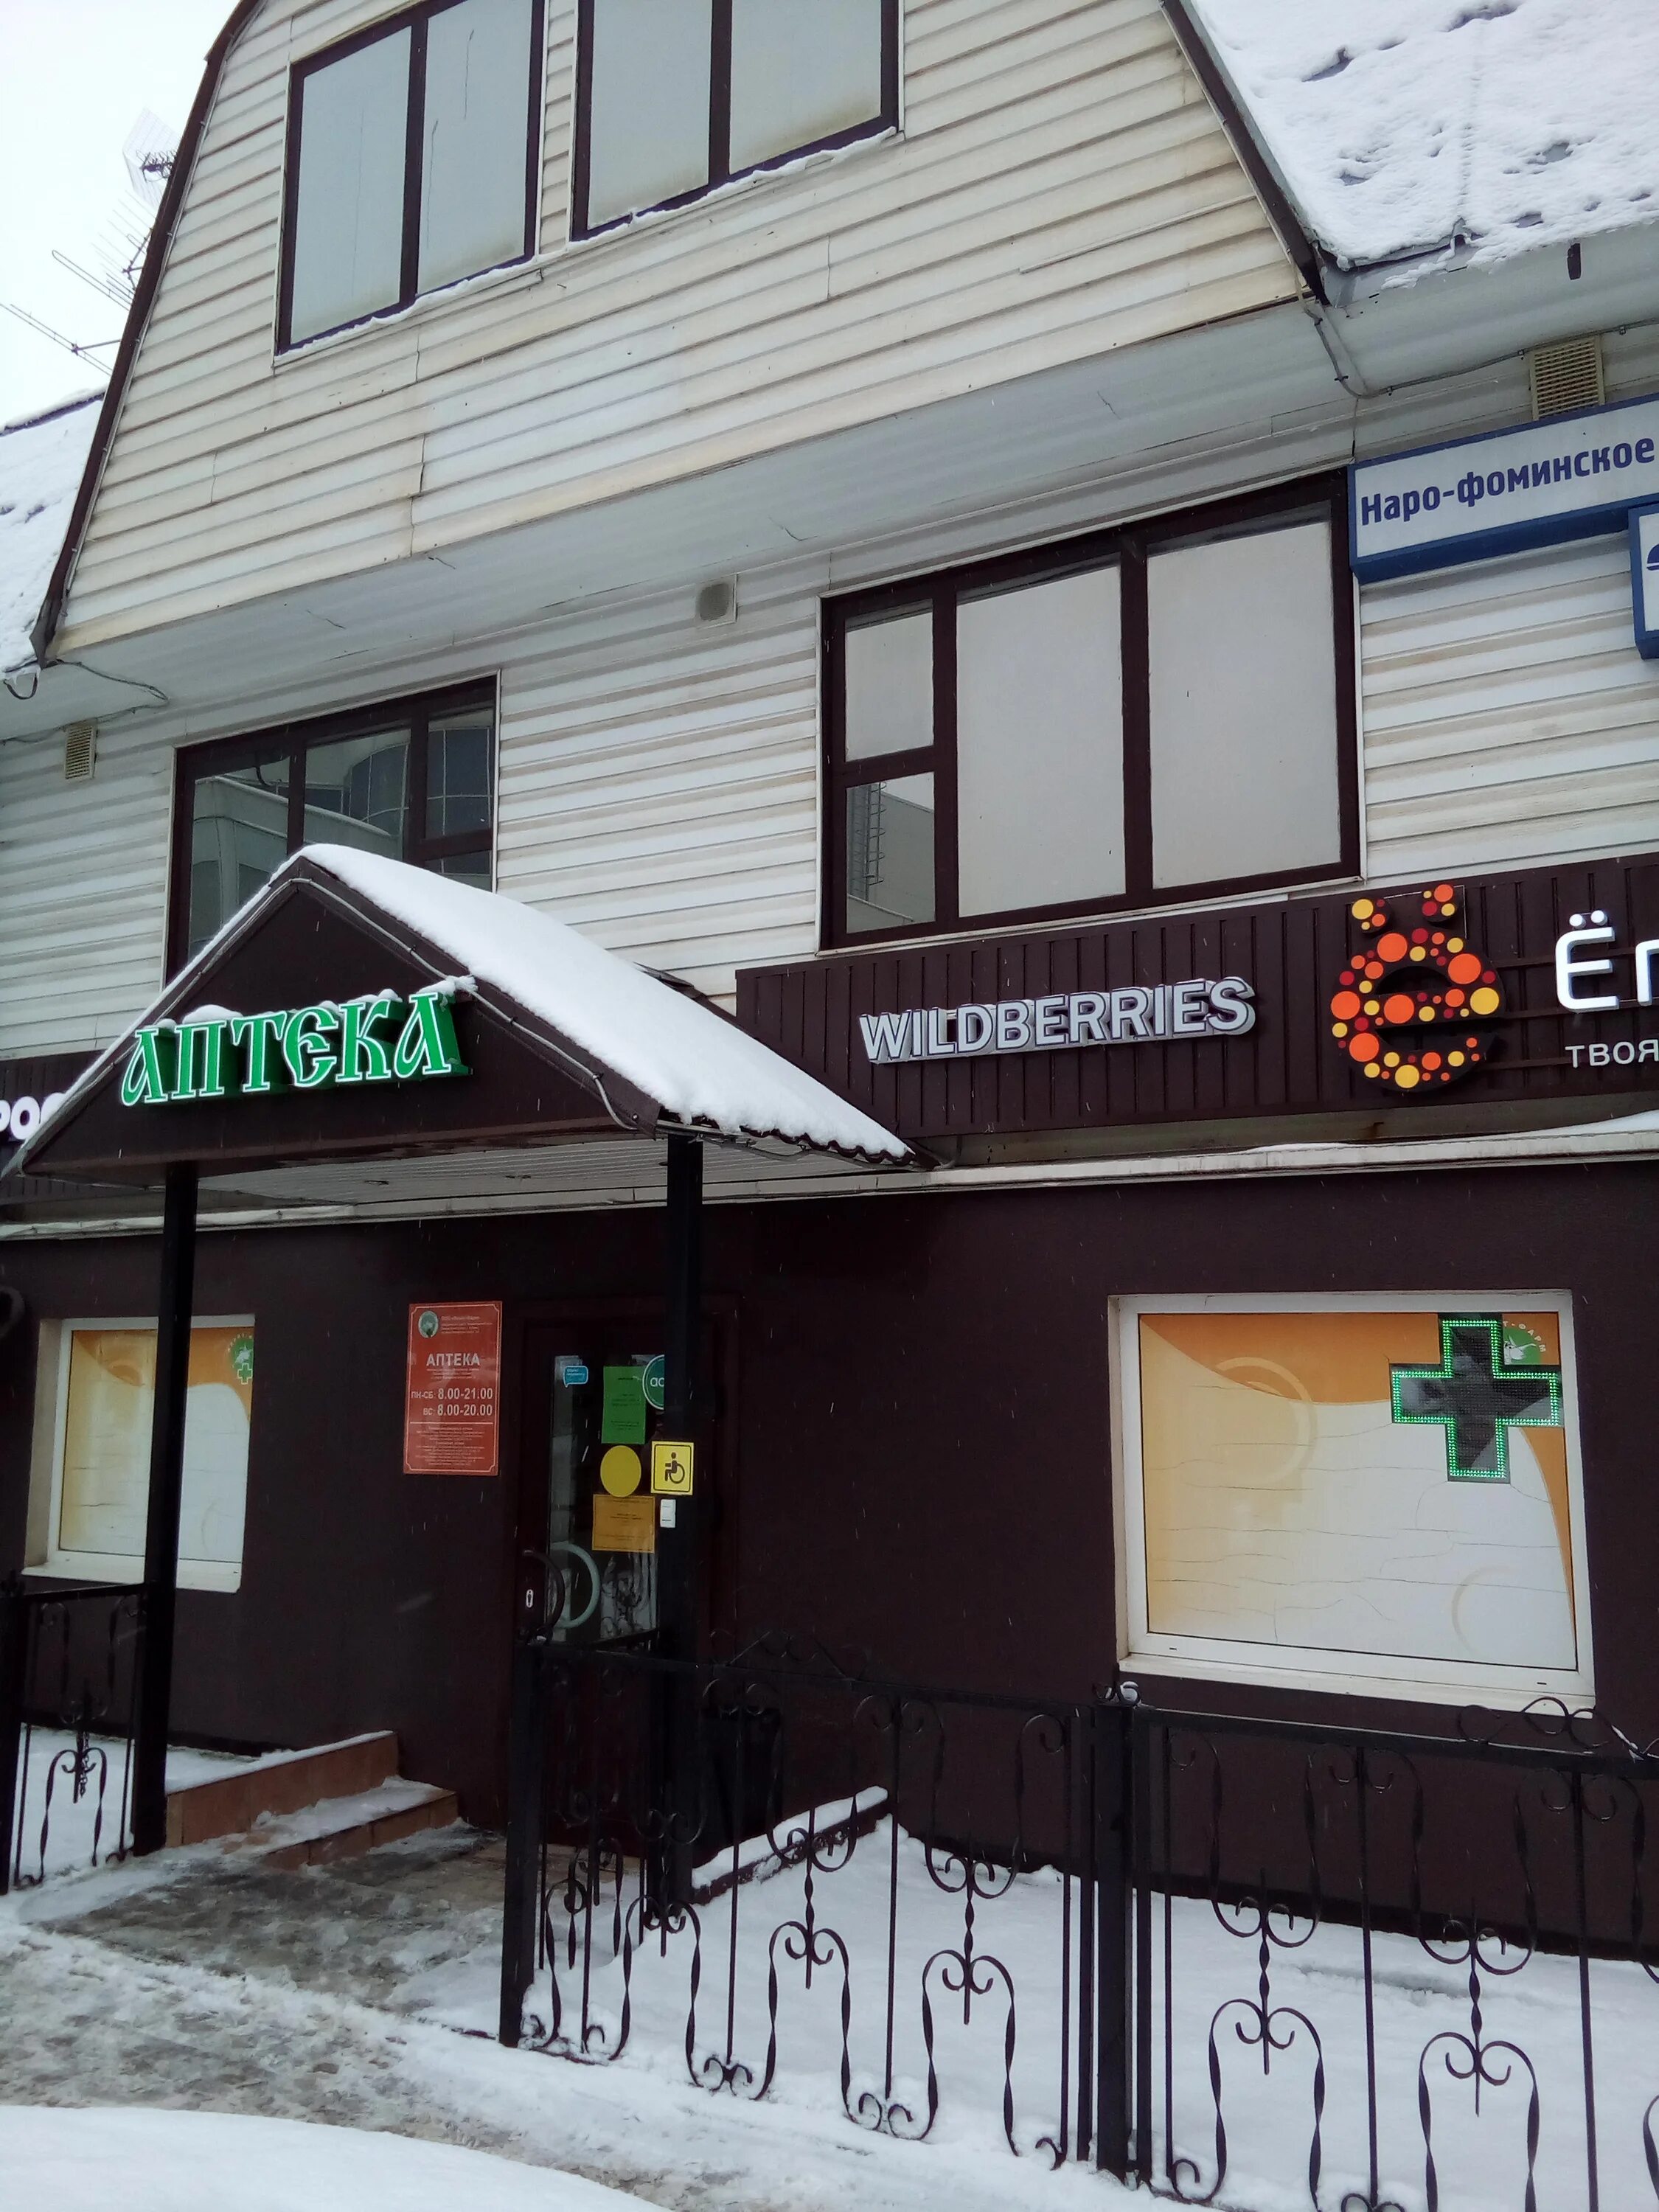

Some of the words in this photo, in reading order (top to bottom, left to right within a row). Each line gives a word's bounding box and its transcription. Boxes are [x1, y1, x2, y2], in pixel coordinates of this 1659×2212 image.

[859, 976, 1256, 1064] WILDBERRIES
[120, 991, 473, 1106] АПТЕКА
[1565, 1039, 1659, 1068] ТВОЯ
[426, 1353, 480, 1366] АПТЕКА
[438, 1388, 493, 1399] 8.00-21.00
[437, 1404, 493, 1416] 8.00-20.00
